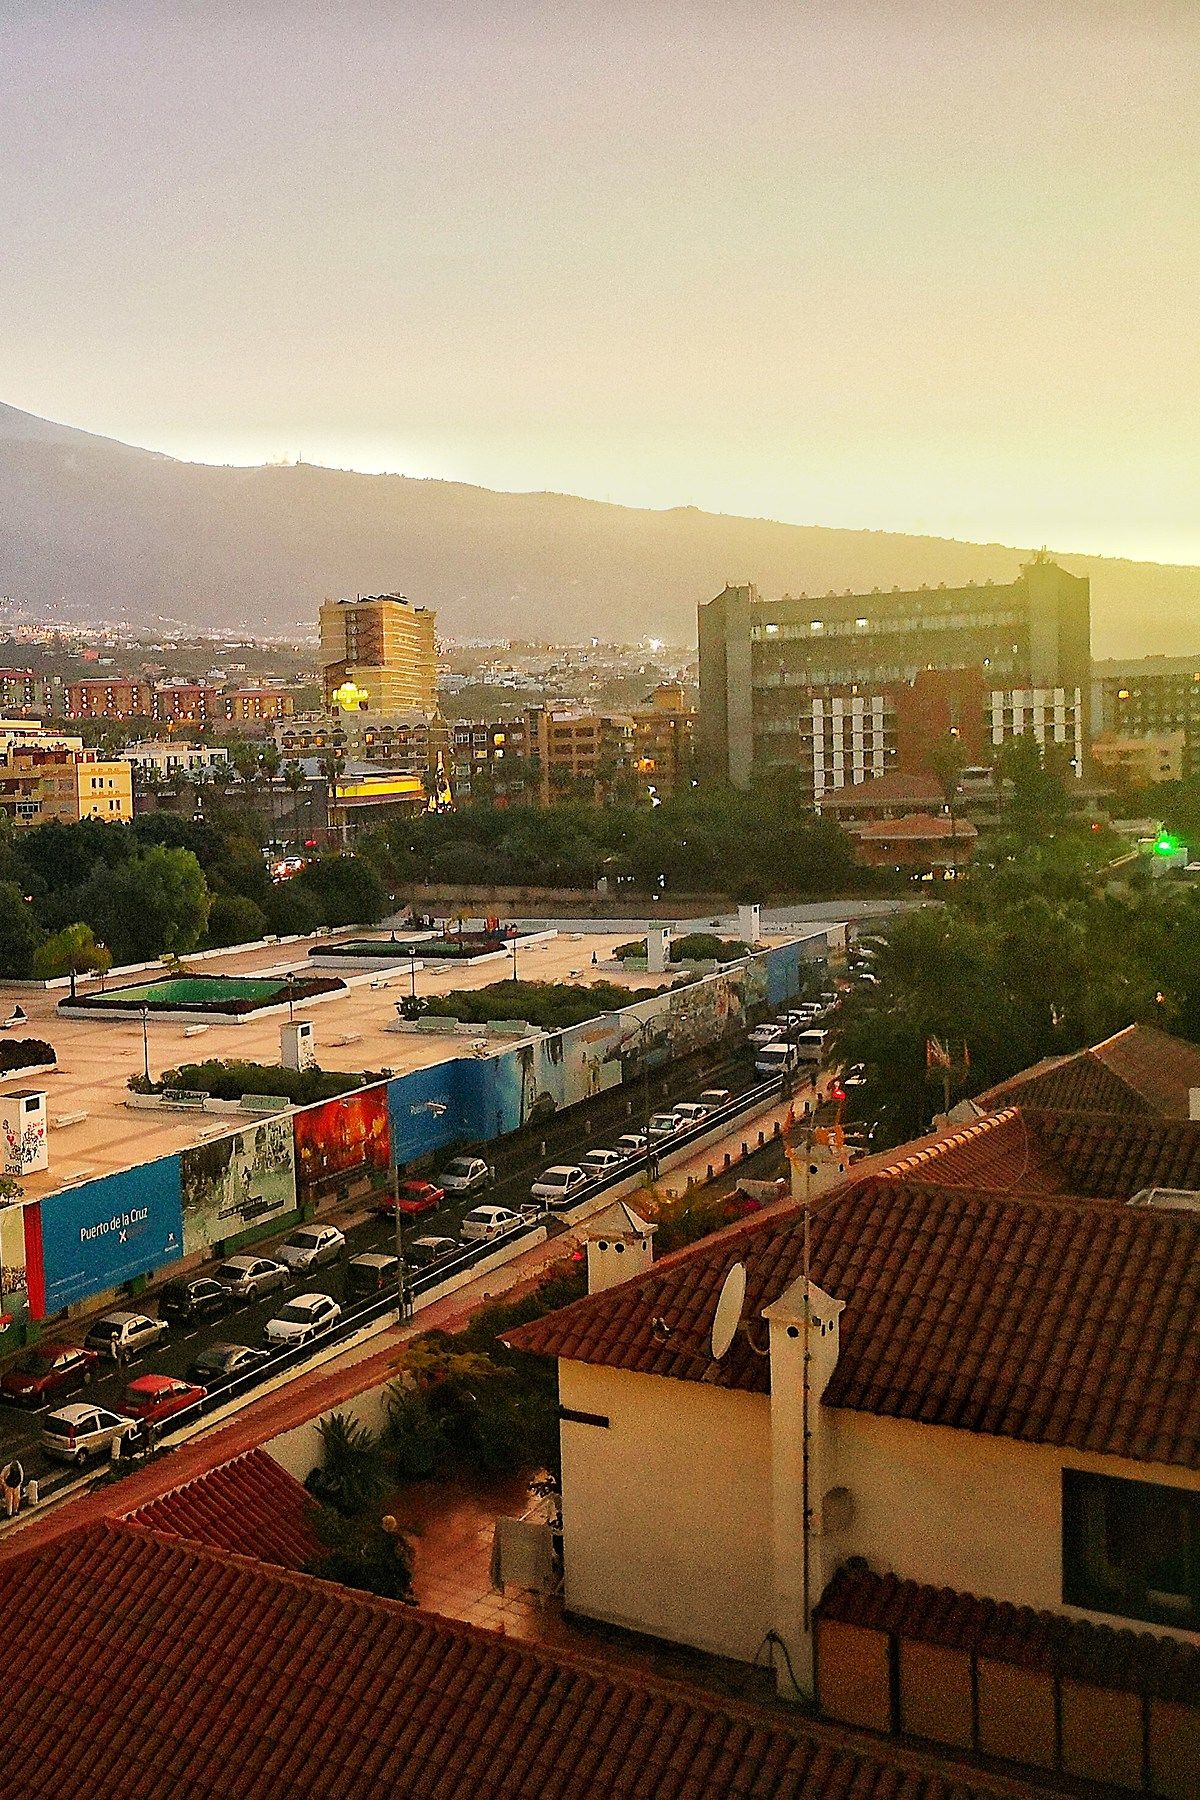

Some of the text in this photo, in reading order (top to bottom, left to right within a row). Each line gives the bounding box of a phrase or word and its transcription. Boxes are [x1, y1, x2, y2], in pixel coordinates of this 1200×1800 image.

[80, 1222, 109, 1241] Puerto
[110, 1217, 121, 1231] de
[122, 1213, 130, 1227] la
[130, 1207, 148, 1222] Cruz
